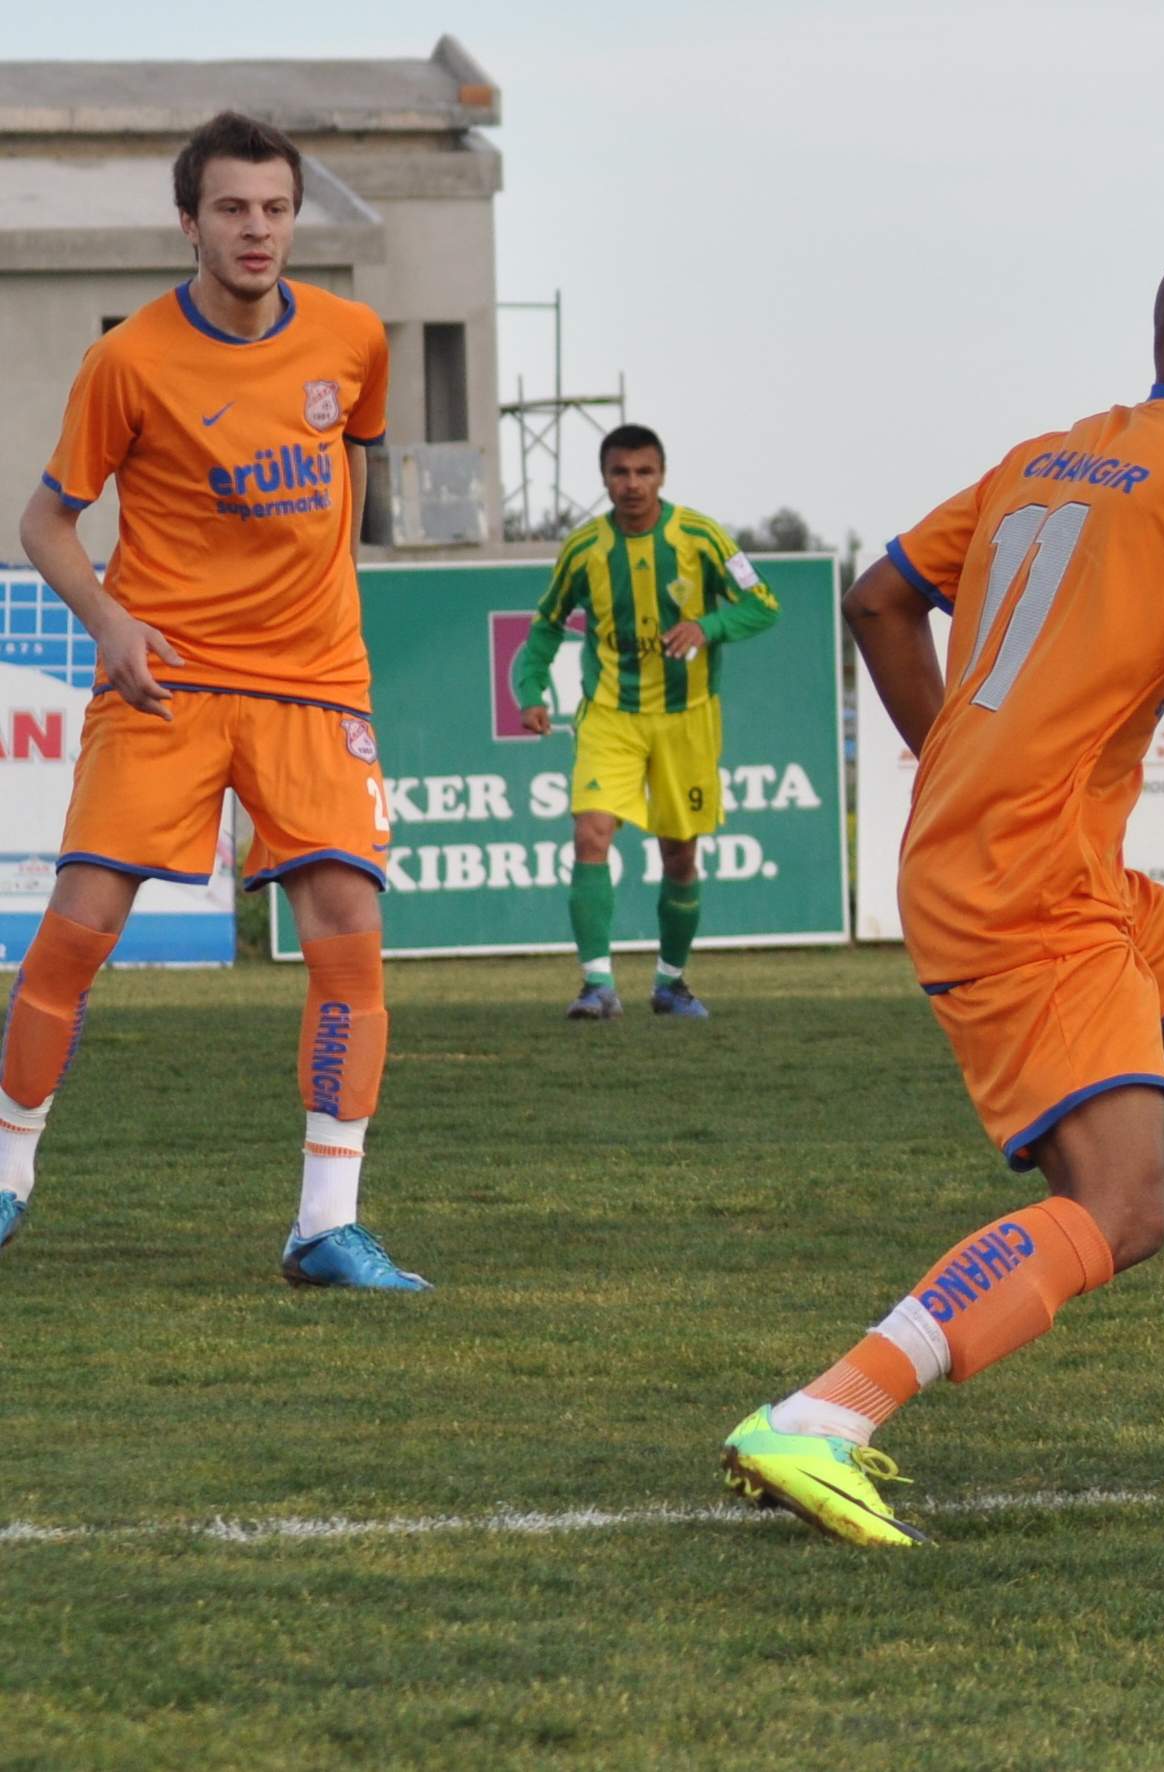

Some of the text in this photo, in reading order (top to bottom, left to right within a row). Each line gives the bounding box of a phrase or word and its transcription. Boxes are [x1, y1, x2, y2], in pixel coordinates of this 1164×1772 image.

[208, 442, 332, 496] erülkü
[959, 501, 1091, 712] 11
[0, 711, 63, 758] N
[383, 774, 513, 822] KER
[688, 786, 704, 812] 9
